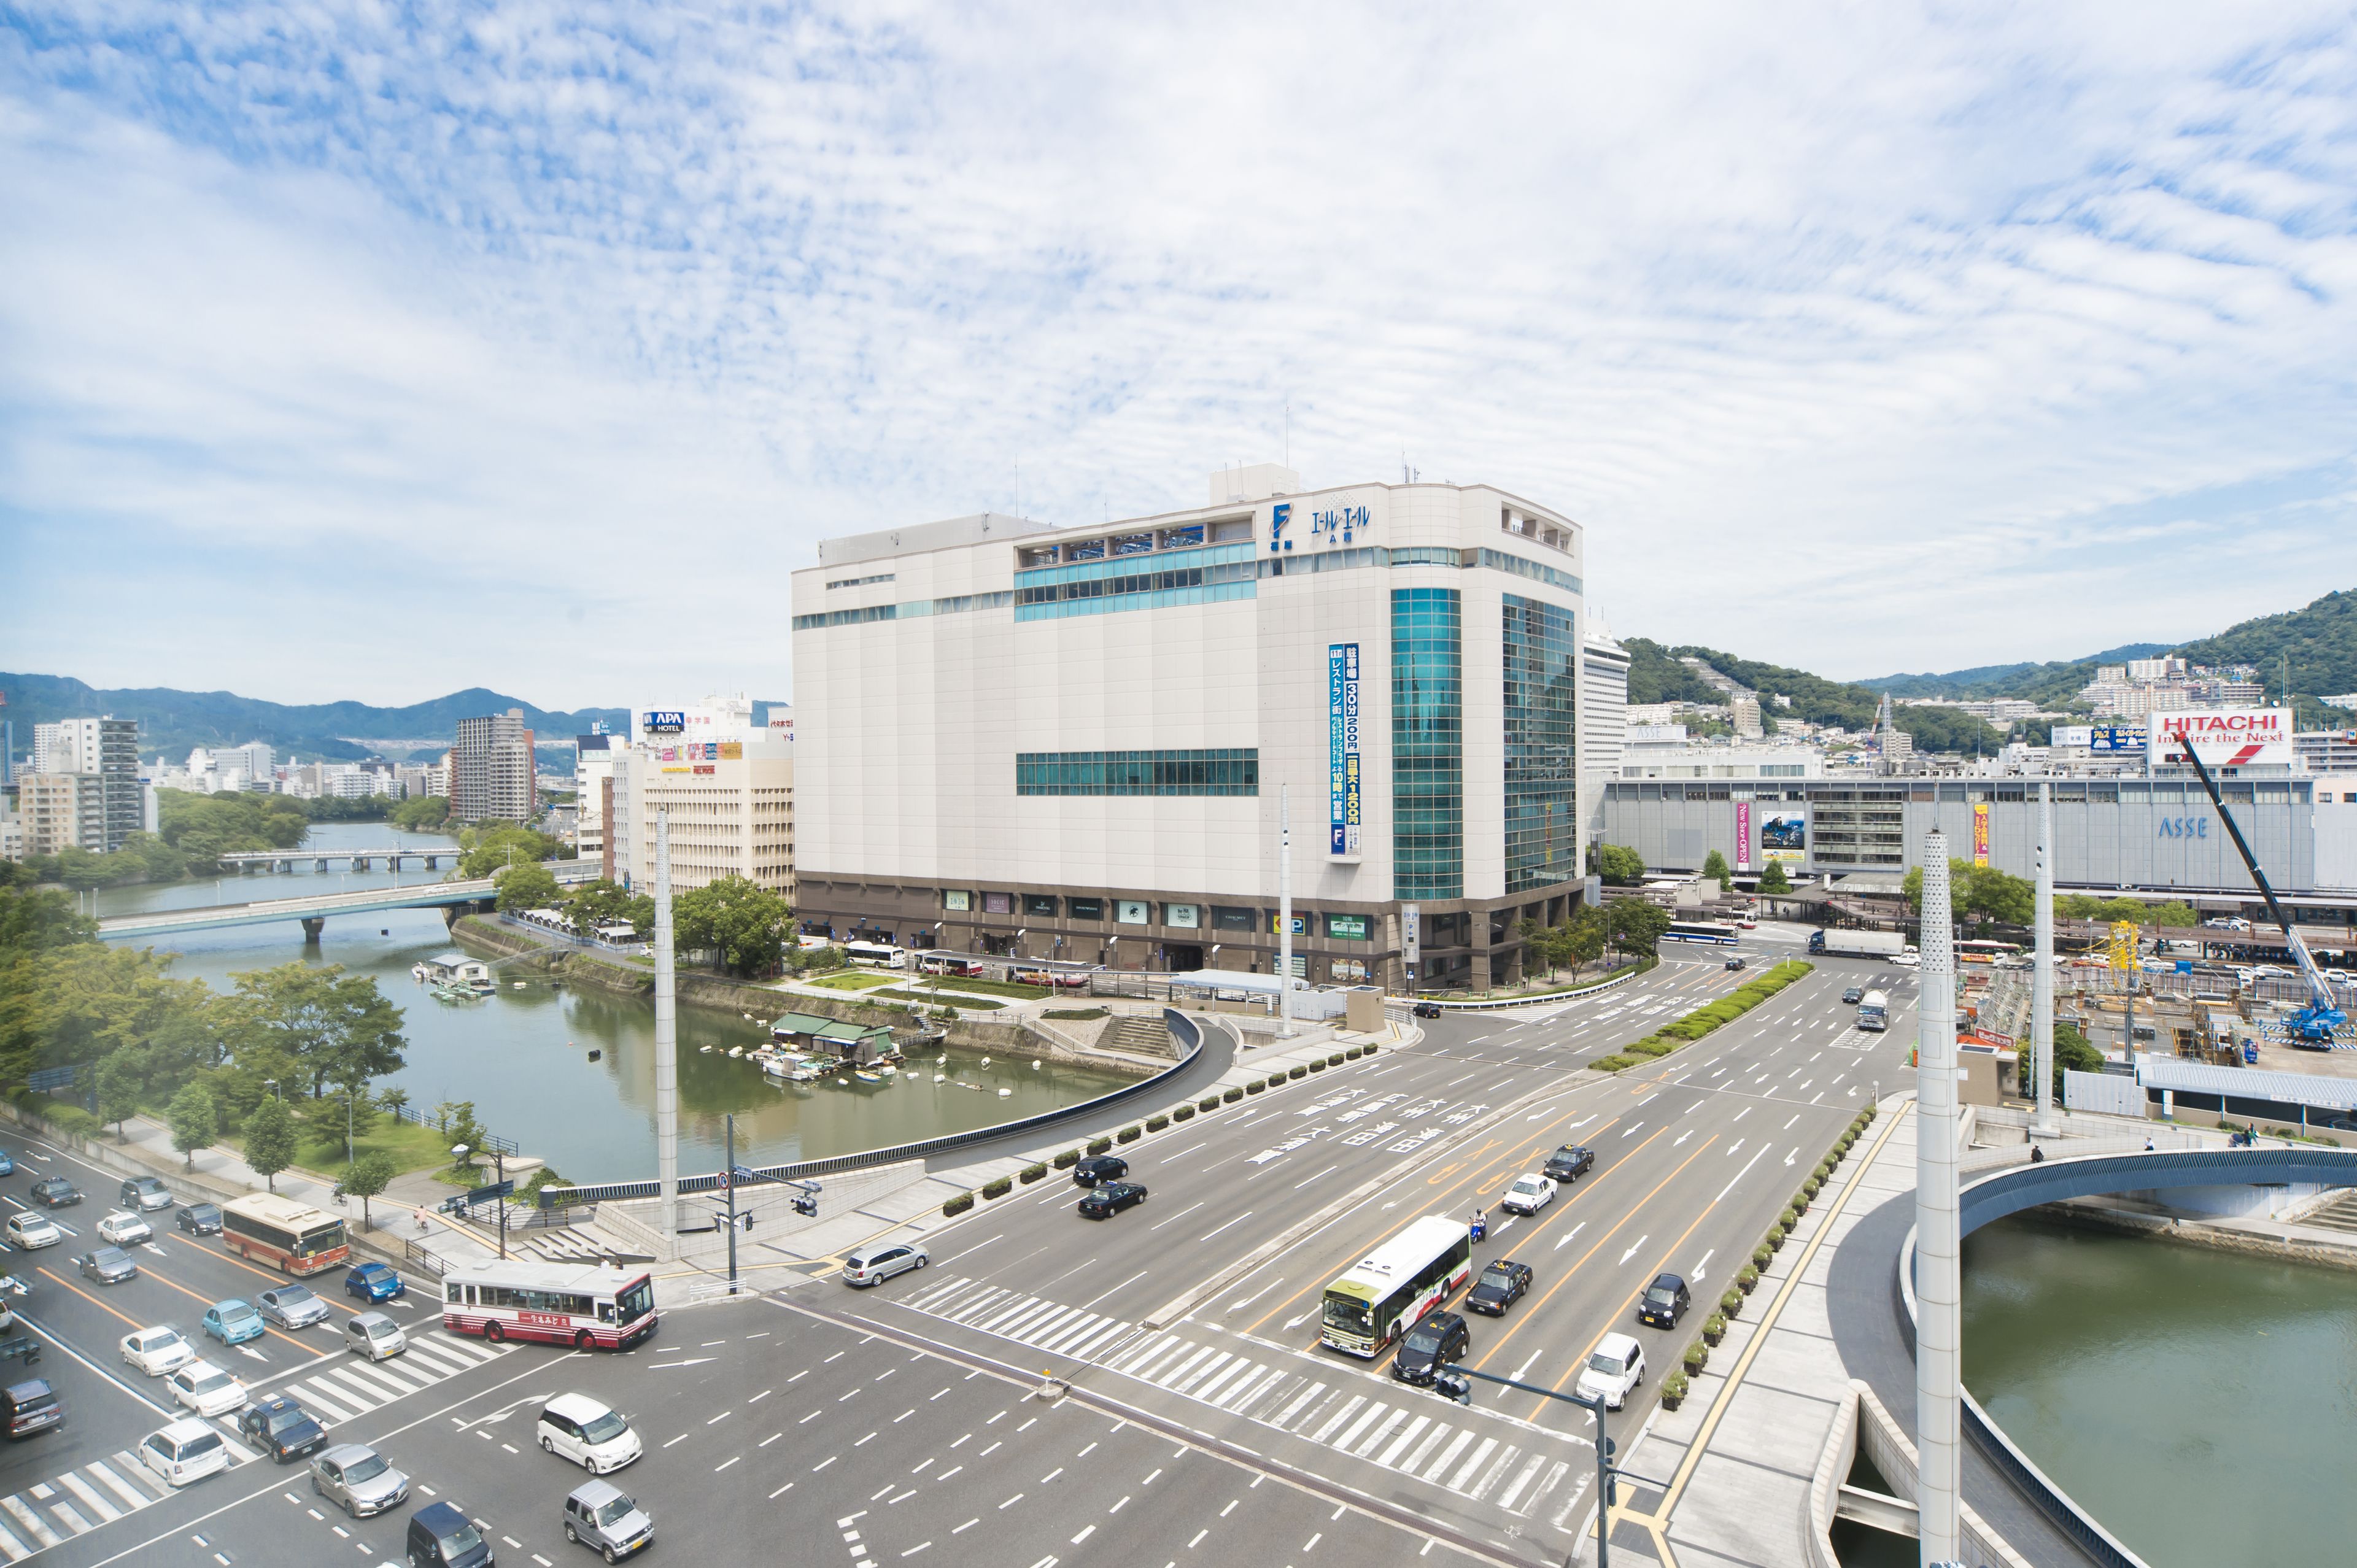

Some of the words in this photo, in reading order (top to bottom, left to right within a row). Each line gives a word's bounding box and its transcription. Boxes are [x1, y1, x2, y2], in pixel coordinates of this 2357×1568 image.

[1332, 660, 1342, 715] レストラン街
[656, 713, 681, 724] APA
[2164, 715, 2277, 732] HITACHI
[2158, 733, 2210, 744] Inire
[2216, 732, 2244, 743] the
[2247, 730, 2285, 742] Next
[2159, 817, 2208, 838] ASSE
[1291, 919, 1302, 932] P
